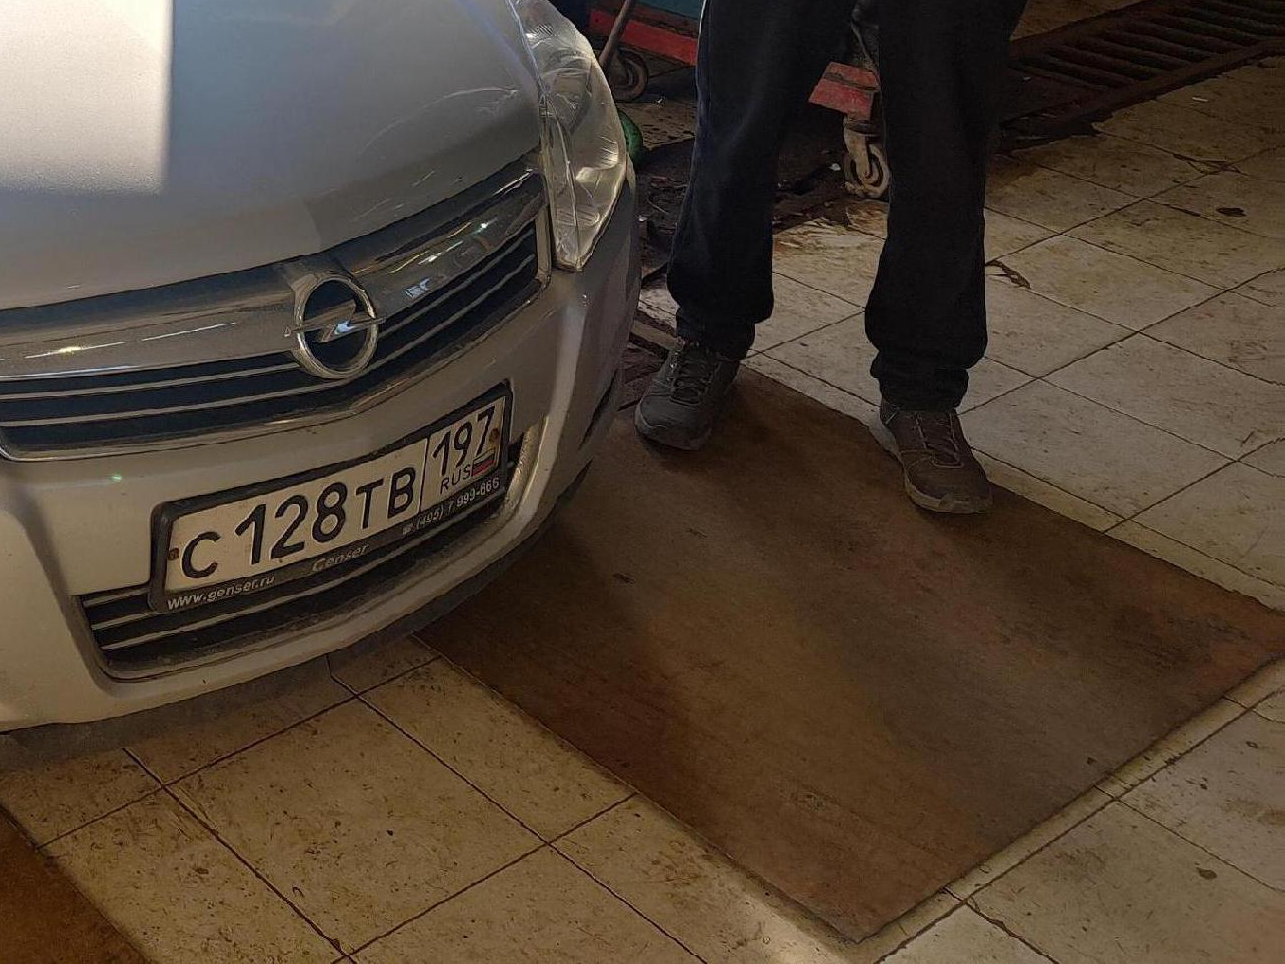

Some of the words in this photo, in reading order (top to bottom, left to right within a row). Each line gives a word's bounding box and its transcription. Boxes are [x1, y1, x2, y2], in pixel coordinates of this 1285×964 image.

[181, 467, 416, 578] С128ТВ
[432, 405, 496, 476] 197
[439, 463, 472, 495] RUS
[167, 574, 275, 611] www.genser.ru
